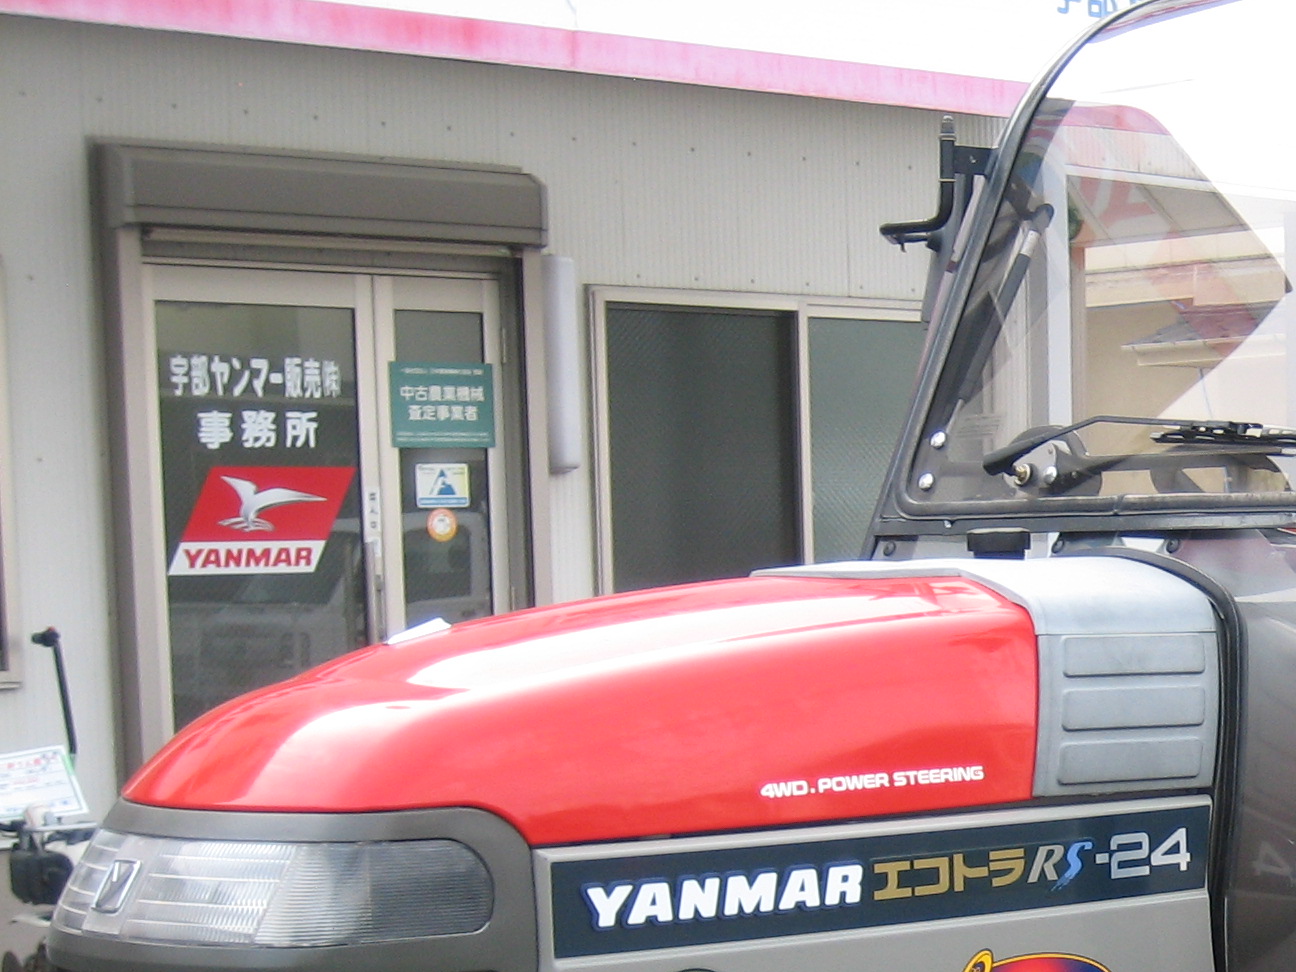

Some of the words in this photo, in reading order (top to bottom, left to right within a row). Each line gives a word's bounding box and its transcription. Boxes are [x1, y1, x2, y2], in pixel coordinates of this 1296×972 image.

[197, 410, 318, 449] 事務所
[183, 547, 313, 569] YANMAR
[818, 773, 889, 793] POWER
[892, 765, 984, 787] STEERING
[585, 863, 863, 929] YANMAR
